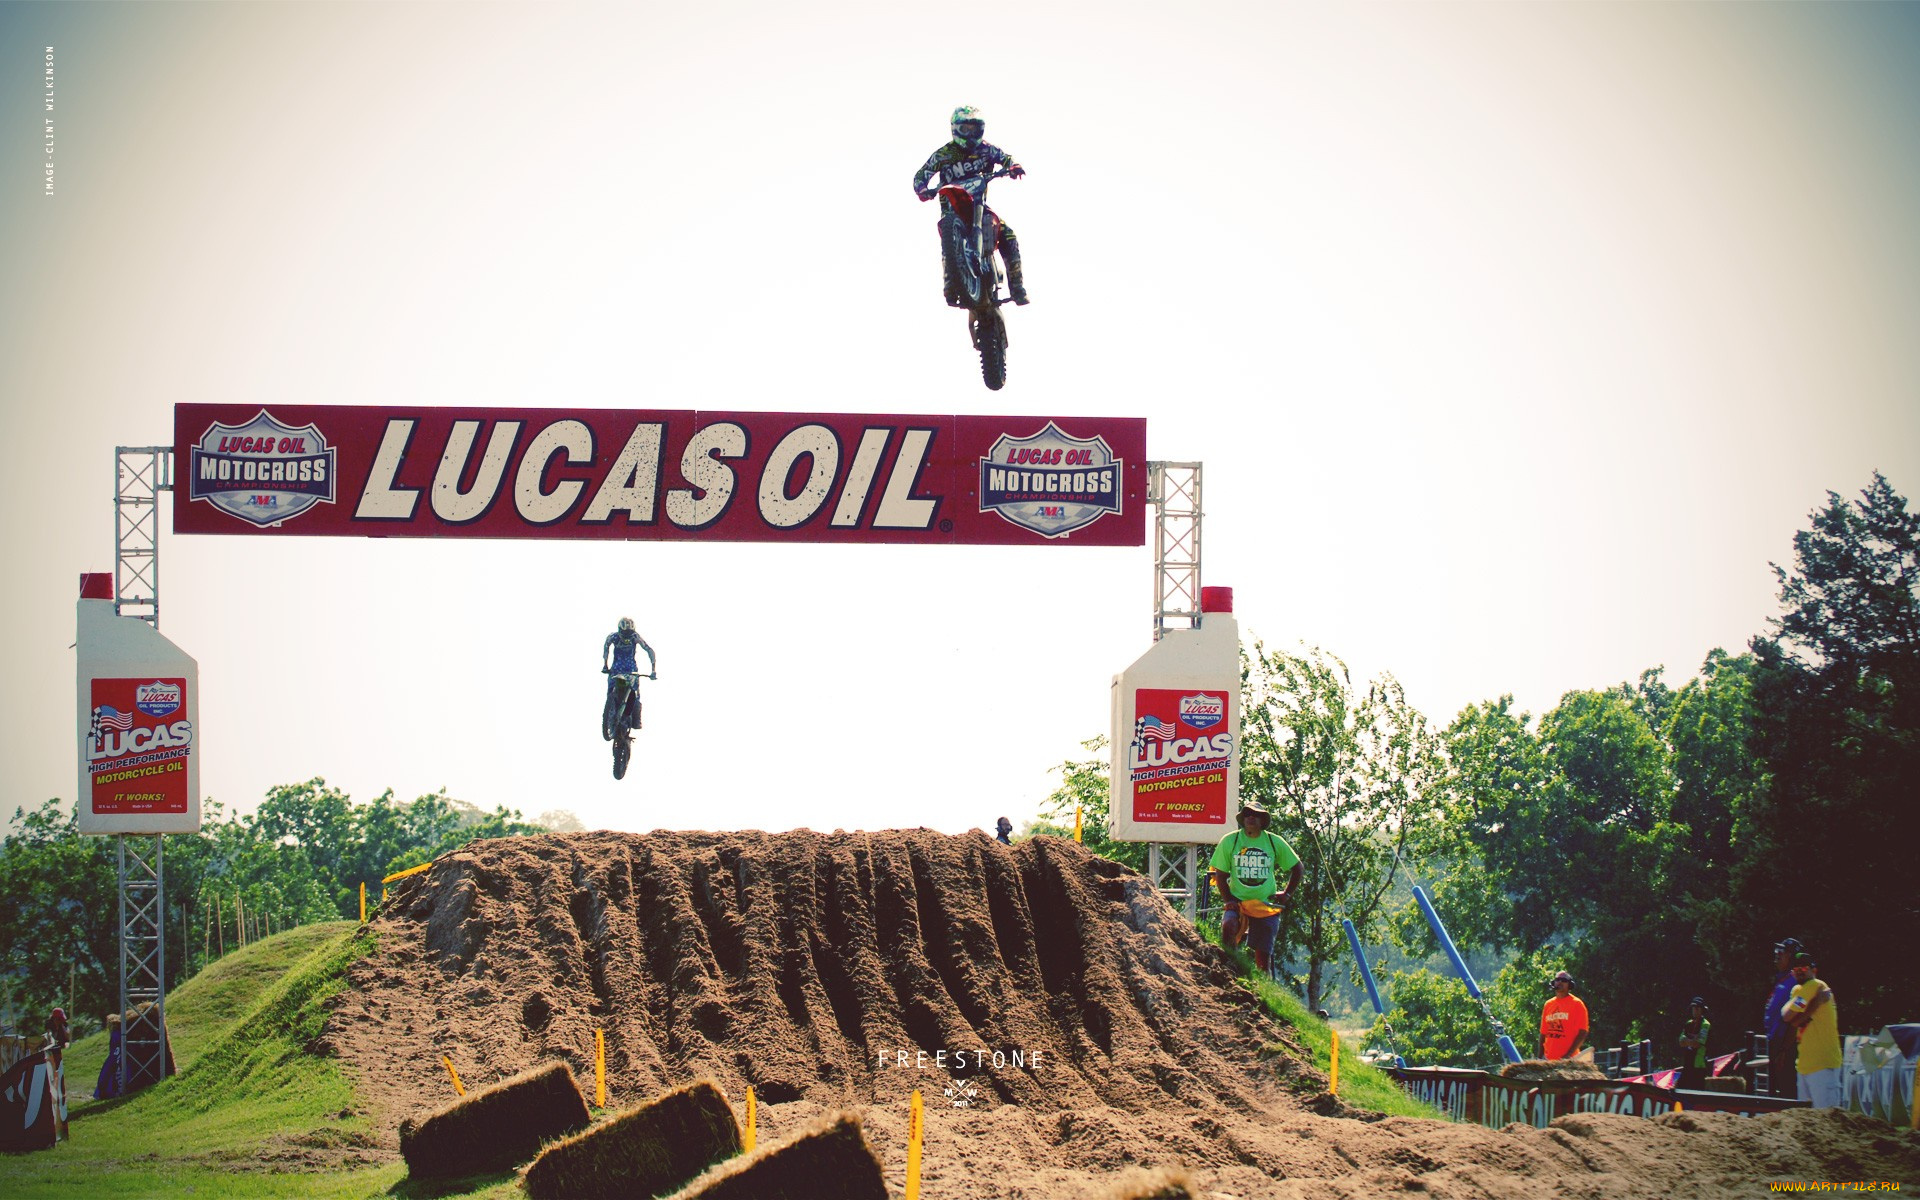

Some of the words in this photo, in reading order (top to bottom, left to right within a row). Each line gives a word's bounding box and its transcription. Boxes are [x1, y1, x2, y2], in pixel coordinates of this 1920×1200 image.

[218, 436, 275, 454] LUCAS
[277, 437, 306, 454] OIL
[1006, 448, 1062, 466] LUCAS
[1064, 449, 1093, 466] OIL
[201, 457, 326, 482] MOTOCROSS
[350, 416, 751, 531] LUCAS
[756, 421, 944, 531] OIL
[989, 468, 1113, 493] MOTOCROSS
[248, 495, 278, 506] AMA
[1005, 493, 1095, 501] CHAMPIONSHIP
[1035, 506, 1065, 517] AMA
[142, 693, 177, 702] LUCAS
[1185, 705, 1220, 714] LUCAS
[86, 720, 192, 761] LUCAS
[88, 760, 113, 774] HIGH
[115, 747, 191, 768] PERFORMANCE
[1129, 733, 1233, 770] LUCAS
[96, 764, 165, 785] MOTORCYCLE
[166, 761, 184, 772] OIL
[1130, 769, 1155, 781] HIGH
[1157, 760, 1231, 777] PERFORMANCE
[1138, 775, 1205, 794] MOTORCYCLE
[1206, 773, 1224, 783] OIL
[114, 793, 124, 801] IT
[126, 793, 166, 801] WORKS!
[1154, 802, 1165, 811] IT
[1166, 803, 1205, 812] WORKS!
